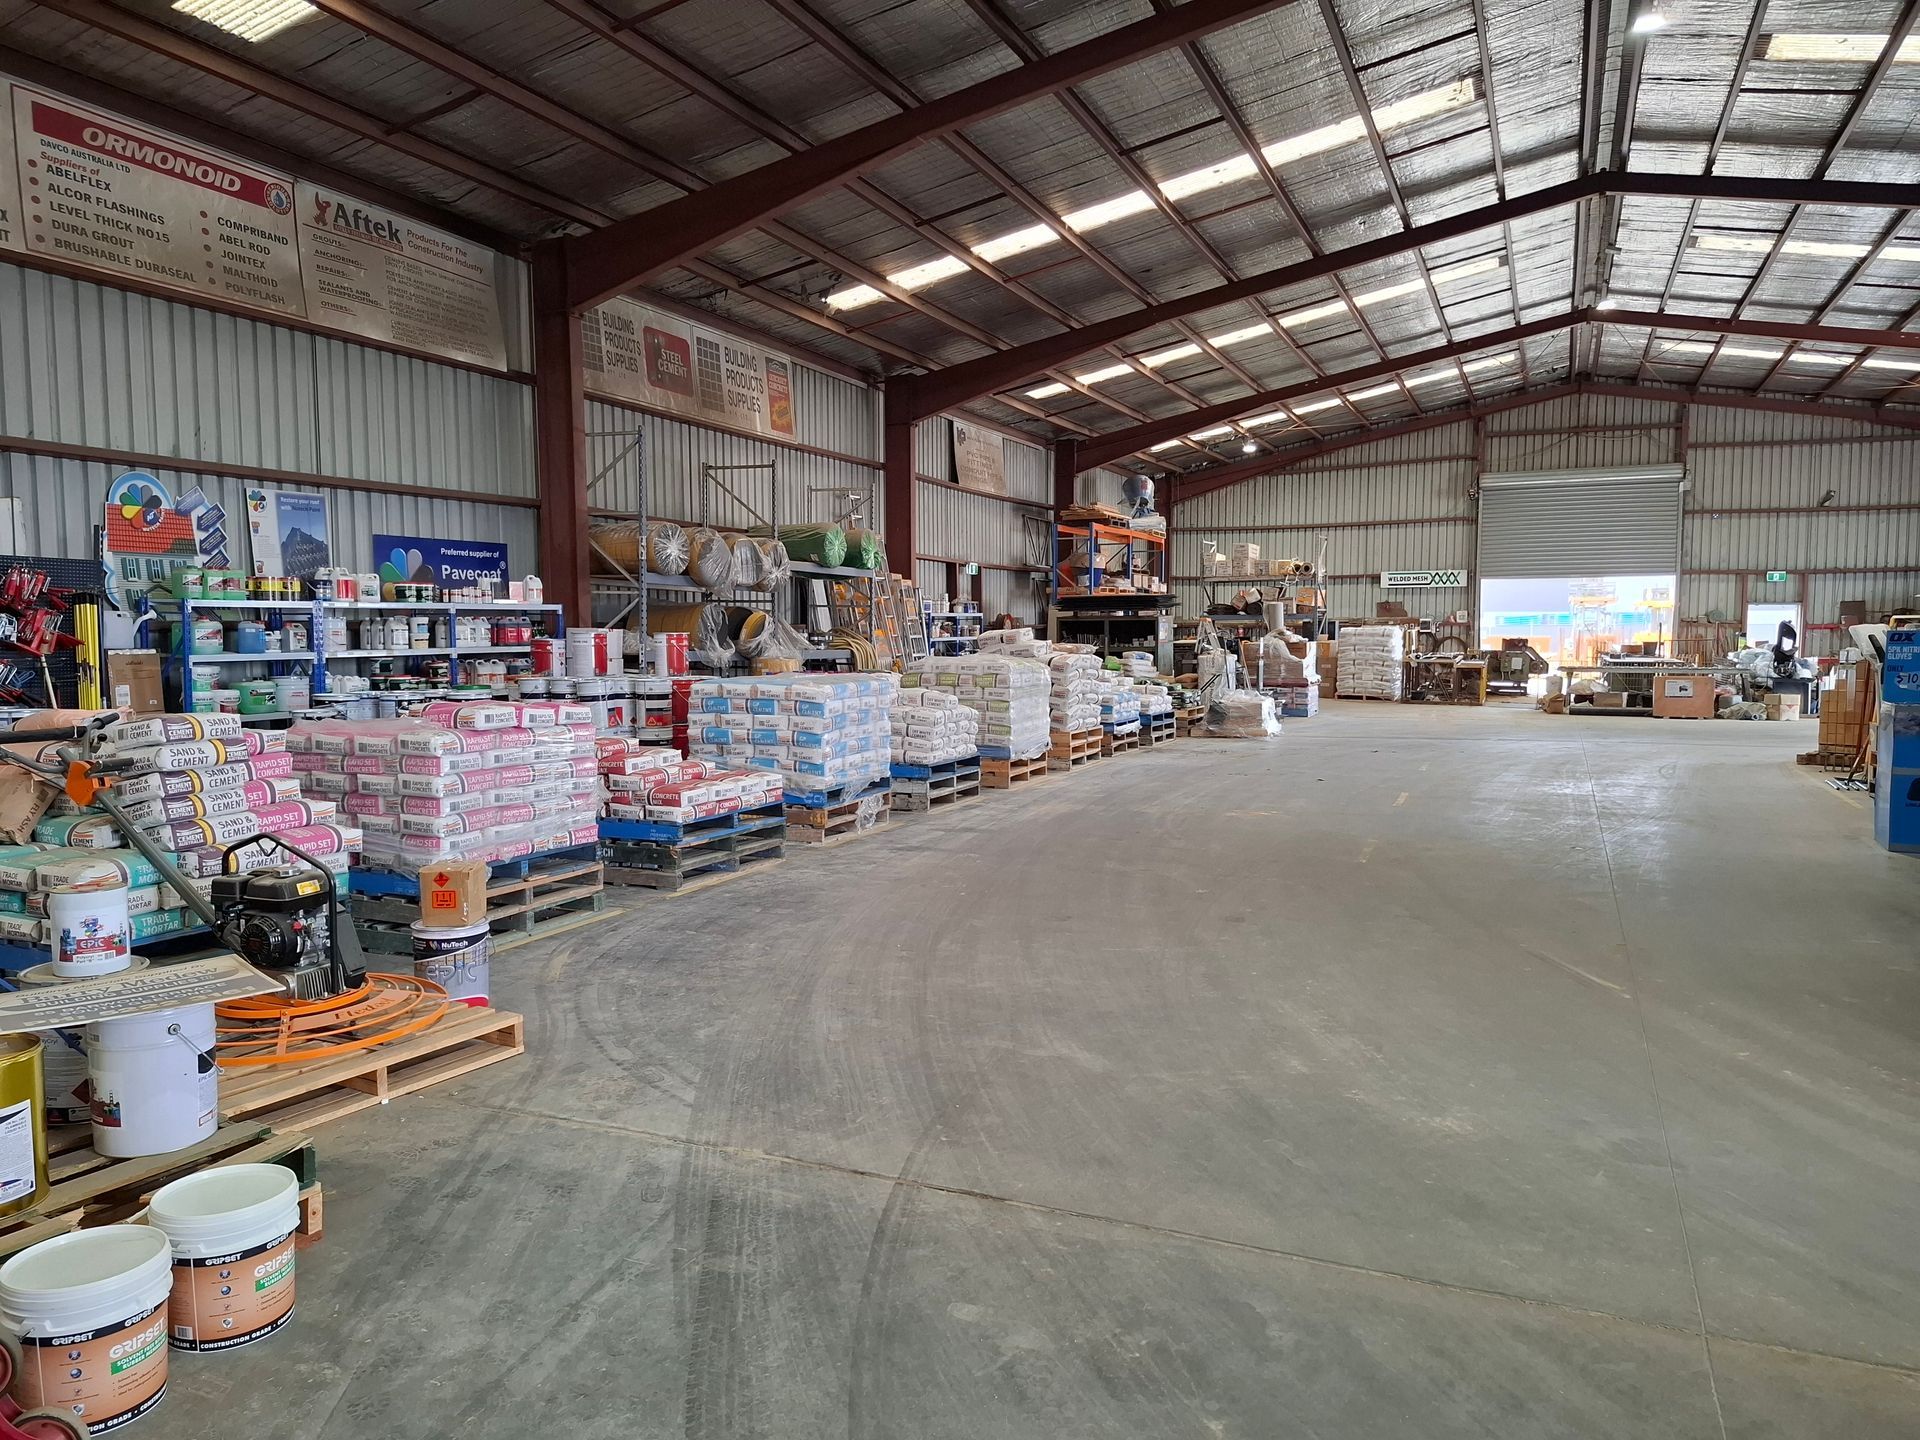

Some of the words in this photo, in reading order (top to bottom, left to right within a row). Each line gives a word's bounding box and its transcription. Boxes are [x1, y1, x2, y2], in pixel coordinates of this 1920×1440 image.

[40, 138, 69, 153] DAVCO
[71, 149, 114, 168] AUSTRALIA
[116, 164, 130, 173] LTD
[82, 127, 241, 191] ORMONOID
[40, 151, 87, 172] Suppliers
[90, 168, 100, 176] of
[47, 164, 112, 192] ABELFLEX
[48, 182, 92, 203] ALCOR
[96, 197, 165, 225] FLASHINGS
[50, 201, 91, 221] LEVEL
[94, 213, 133, 232] THICK
[137, 225, 170, 243] NO15
[333, 203, 401, 244] Aftek
[52, 219, 88, 237] DURA
[92, 231, 135, 249] GROUT
[218, 217, 289, 245] COMPRIBAND
[219, 233, 246, 248] ABEL
[250, 242, 270, 255] ROD
[407, 229, 439, 247] Products
[442, 241, 452, 251] For
[455, 245, 467, 257] The
[55, 238, 131, 265] BRUSHABLE
[135, 258, 197, 283] DURASEAL
[221, 250, 265, 269] JOINTEX
[408, 241, 454, 263] Construction
[456, 256, 484, 274] Industry
[223, 266, 278, 287] MALTHOID
[226, 282, 285, 304] POLYFLASH
[319, 279, 353, 293] SEALANTS
[356, 288, 371, 298] AND
[602, 311, 634, 335] BUILDING
[604, 331, 642, 356] PRODUCTS
[606, 352, 639, 373] SUPPLIES
[661, 349, 683, 366] STEEL
[724, 346, 757, 372] BUILDING
[658, 359, 687, 378] CEMENT
[726, 368, 764, 394] PRODUCTS
[728, 391, 761, 414] SUPPLIES
[440, 548, 468, 557] Preferred
[1889, 633, 1916, 642] OX
[130, 724, 145, 732] SAND
[206, 718, 230, 726] SAND
[130, 730, 152, 739] CEMENT
[210, 727, 241, 737] CEMENT
[170, 746, 195, 756] SAND
[603, 743, 624, 752] CONCRETE
[134, 763, 154, 772] CEMENT
[171, 756, 210, 768] CEMENT
[256, 759, 277, 768] RAPID
[278, 757, 291, 765] SET
[205, 768, 230, 777] SAND
[257, 766, 291, 777] CONCRETE
[645, 773, 665, 783] CONCRETE
[683, 767, 703, 775] CONCRETE
[128, 780, 144, 788] SAND
[209, 776, 240, 788] CEMENT
[128, 784, 151, 795] CEMENT
[208, 794, 233, 802] SAND
[720, 800, 739, 808] CONCRETE
[30, 803, 40, 815] FLY
[212, 800, 244, 812] CEMENT
[132, 811, 153, 821] CEMENT
[258, 816, 282, 826] RAPID
[284, 813, 299, 821] SET
[16, 817, 31, 833] ASH
[218, 819, 243, 828] SAND
[177, 834, 204, 842] CEMENT
[222, 824, 256, 839] CEMENT
[245, 856, 279, 870] CEMENT
[2, 871, 18, 880] TRADE
[53, 875, 69, 884] TRADE
[2, 879, 23, 887] MORTAR
[142, 913, 170, 926] TRADE
[7, 923, 22, 931] TRADE
[142, 922, 179, 937] MORTAR
[35, 992, 117, 1008] BUILDING
[120, 978, 199, 994] SUPPLIES
[150, 982, 228, 998] TERRACE
[205, 1253, 243, 1265] GRIPSET
[125, 1307, 155, 1327] GRIPSET
[52, 1331, 96, 1345] GRIPSET
[110, 1317, 165, 1359] GRIPSET
[201, 1335, 250, 1349] CONSTRUCTION
[252, 1326, 271, 1338] GRADE
[116, 1349, 144, 1367] SOLVENT
[122, 1354, 145, 1369] RUBBER
[108, 1413, 132, 1426] GRADE
